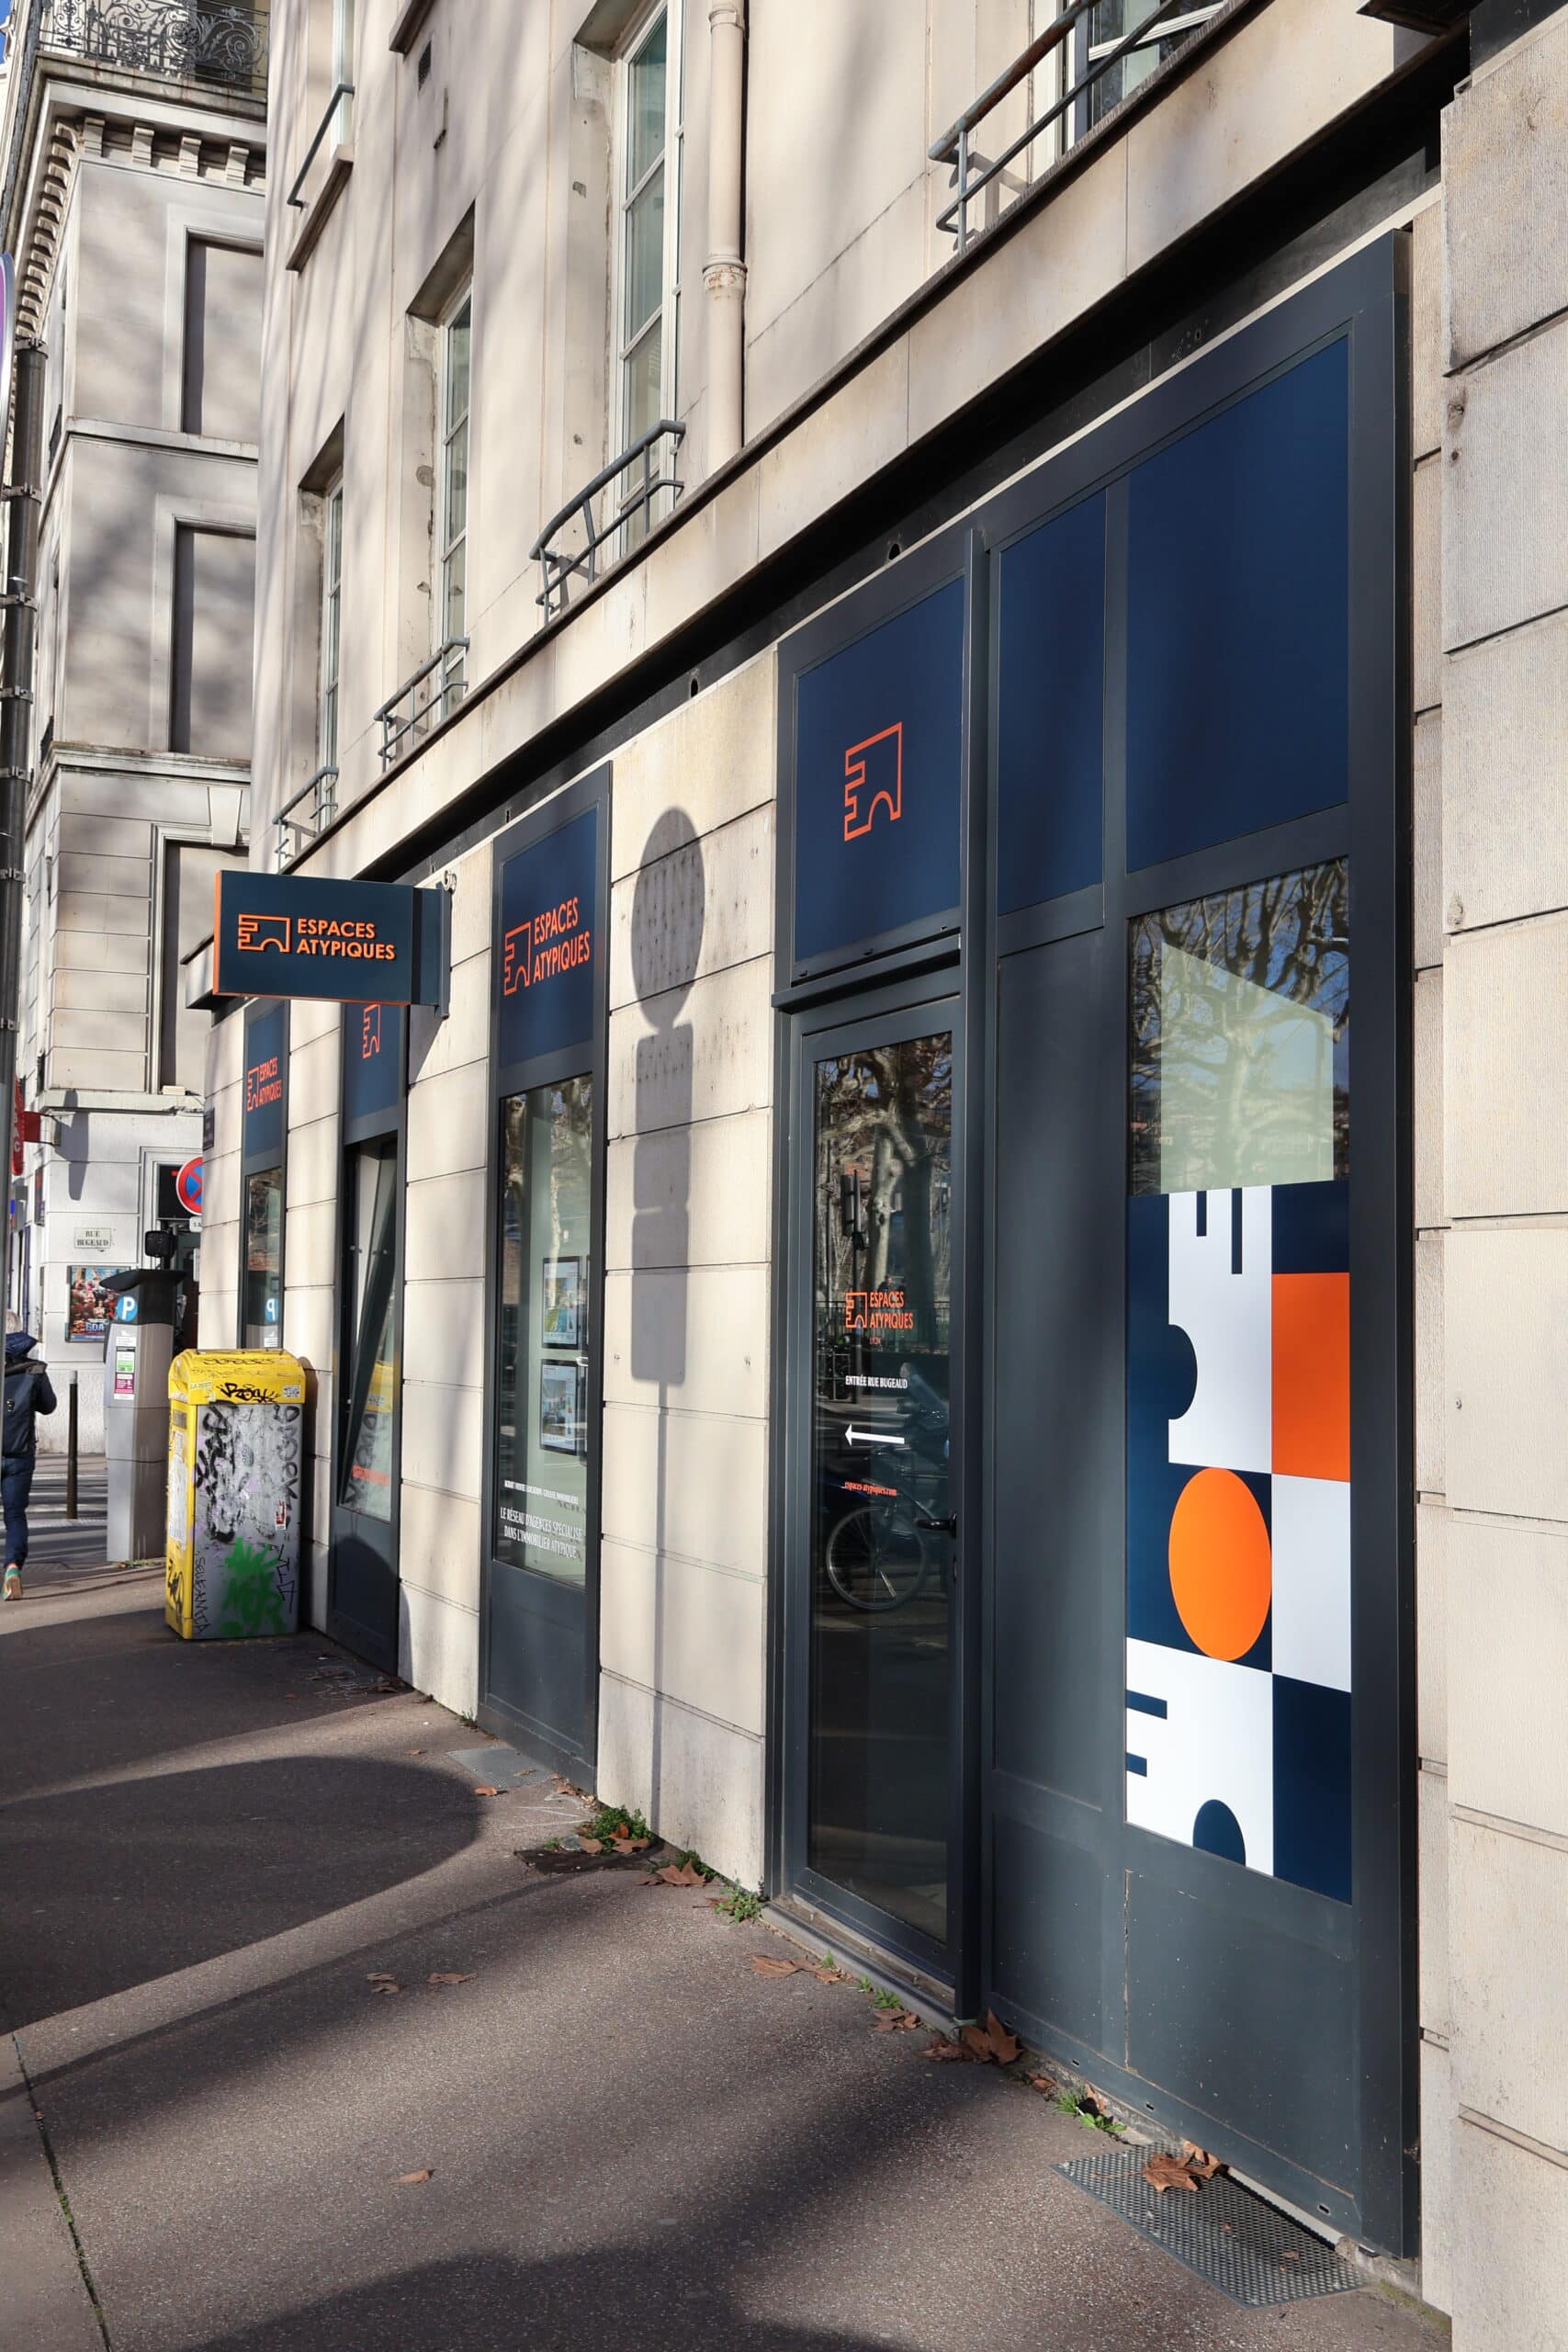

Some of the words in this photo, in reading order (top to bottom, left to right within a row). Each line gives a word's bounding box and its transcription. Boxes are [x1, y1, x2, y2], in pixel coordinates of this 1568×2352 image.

[297, 918, 376, 938] ESPACES
[534, 897, 579, 945] ESPACES
[296, 938, 396, 961] ATYPIQUES
[533, 932, 591, 984] ATYPIQUES
[76, 1238, 109, 1247] BUGEAUD
[869, 1291, 904, 1308] ESPACES
[869, 1312, 914, 1329] ATYPIQUES
[845, 1374, 867, 1386] ENTRÉE
[868, 1376, 879, 1387] RUE
[879, 1377, 908, 1389] BUGEAUD
[500, 1507, 507, 1519] LE
